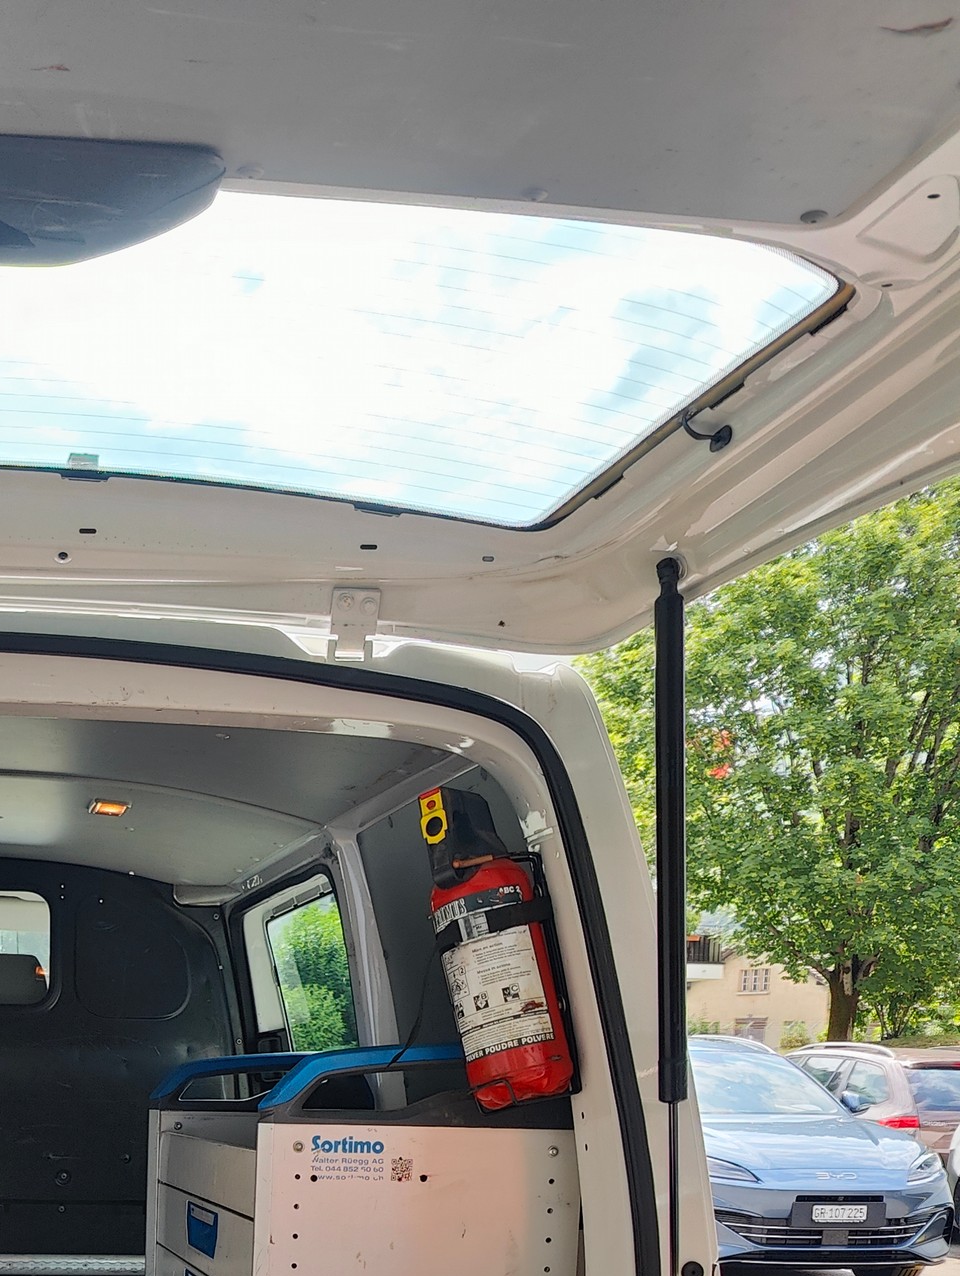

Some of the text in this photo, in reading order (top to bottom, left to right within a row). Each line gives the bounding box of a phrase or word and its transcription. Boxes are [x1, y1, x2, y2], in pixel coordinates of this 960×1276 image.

[485, 1039, 520, 1055] POUDRE
[521, 1033, 555, 1046] POLVERE
[311, 1135, 384, 1154] Sortimo
[341, 1157, 369, 1166] Rüegg
[815, 1172, 857, 1181] BYD
